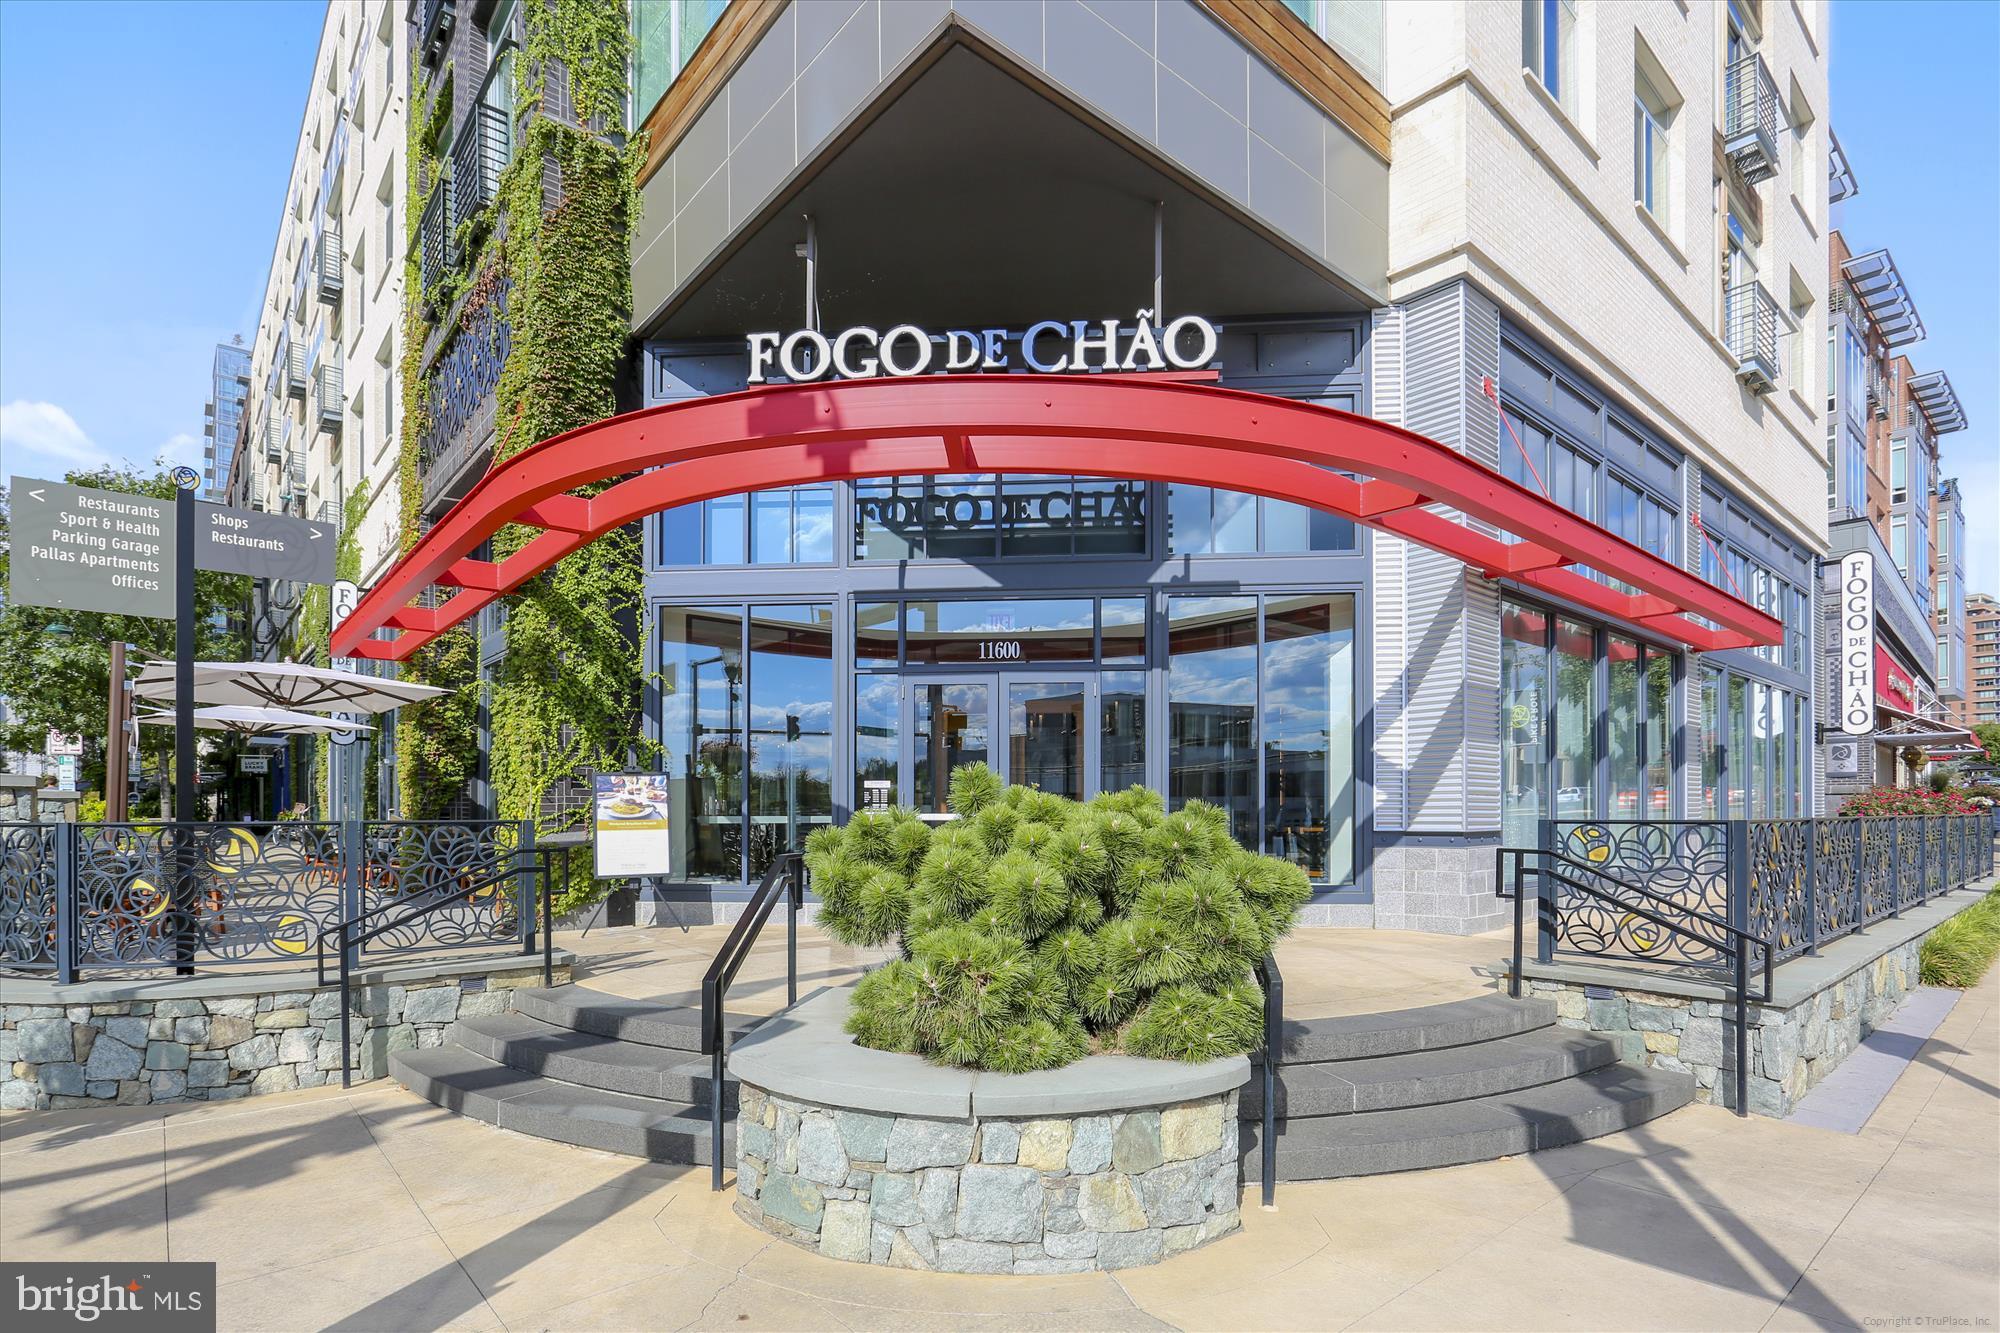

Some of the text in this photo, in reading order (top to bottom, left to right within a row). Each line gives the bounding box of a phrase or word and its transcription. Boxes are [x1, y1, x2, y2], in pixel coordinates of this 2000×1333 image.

[746, 308, 1217, 383] FOGO DE CHÃO
[78, 495, 160, 519] Restaurants
[60, 511, 160, 537] Sport & Health
[211, 513, 249, 530] Shops
[52, 529, 160, 557] Parking Garage
[211, 531, 285, 552] Restaurants
[31, 545, 160, 573] Pallas Apartments
[112, 574, 159, 591] Offices
[1846, 561, 1868, 631] FOGO
[978, 641, 1020, 659] 11600
[1849, 637, 1866, 646] DE
[1848, 651, 1869, 726] CHÃO
